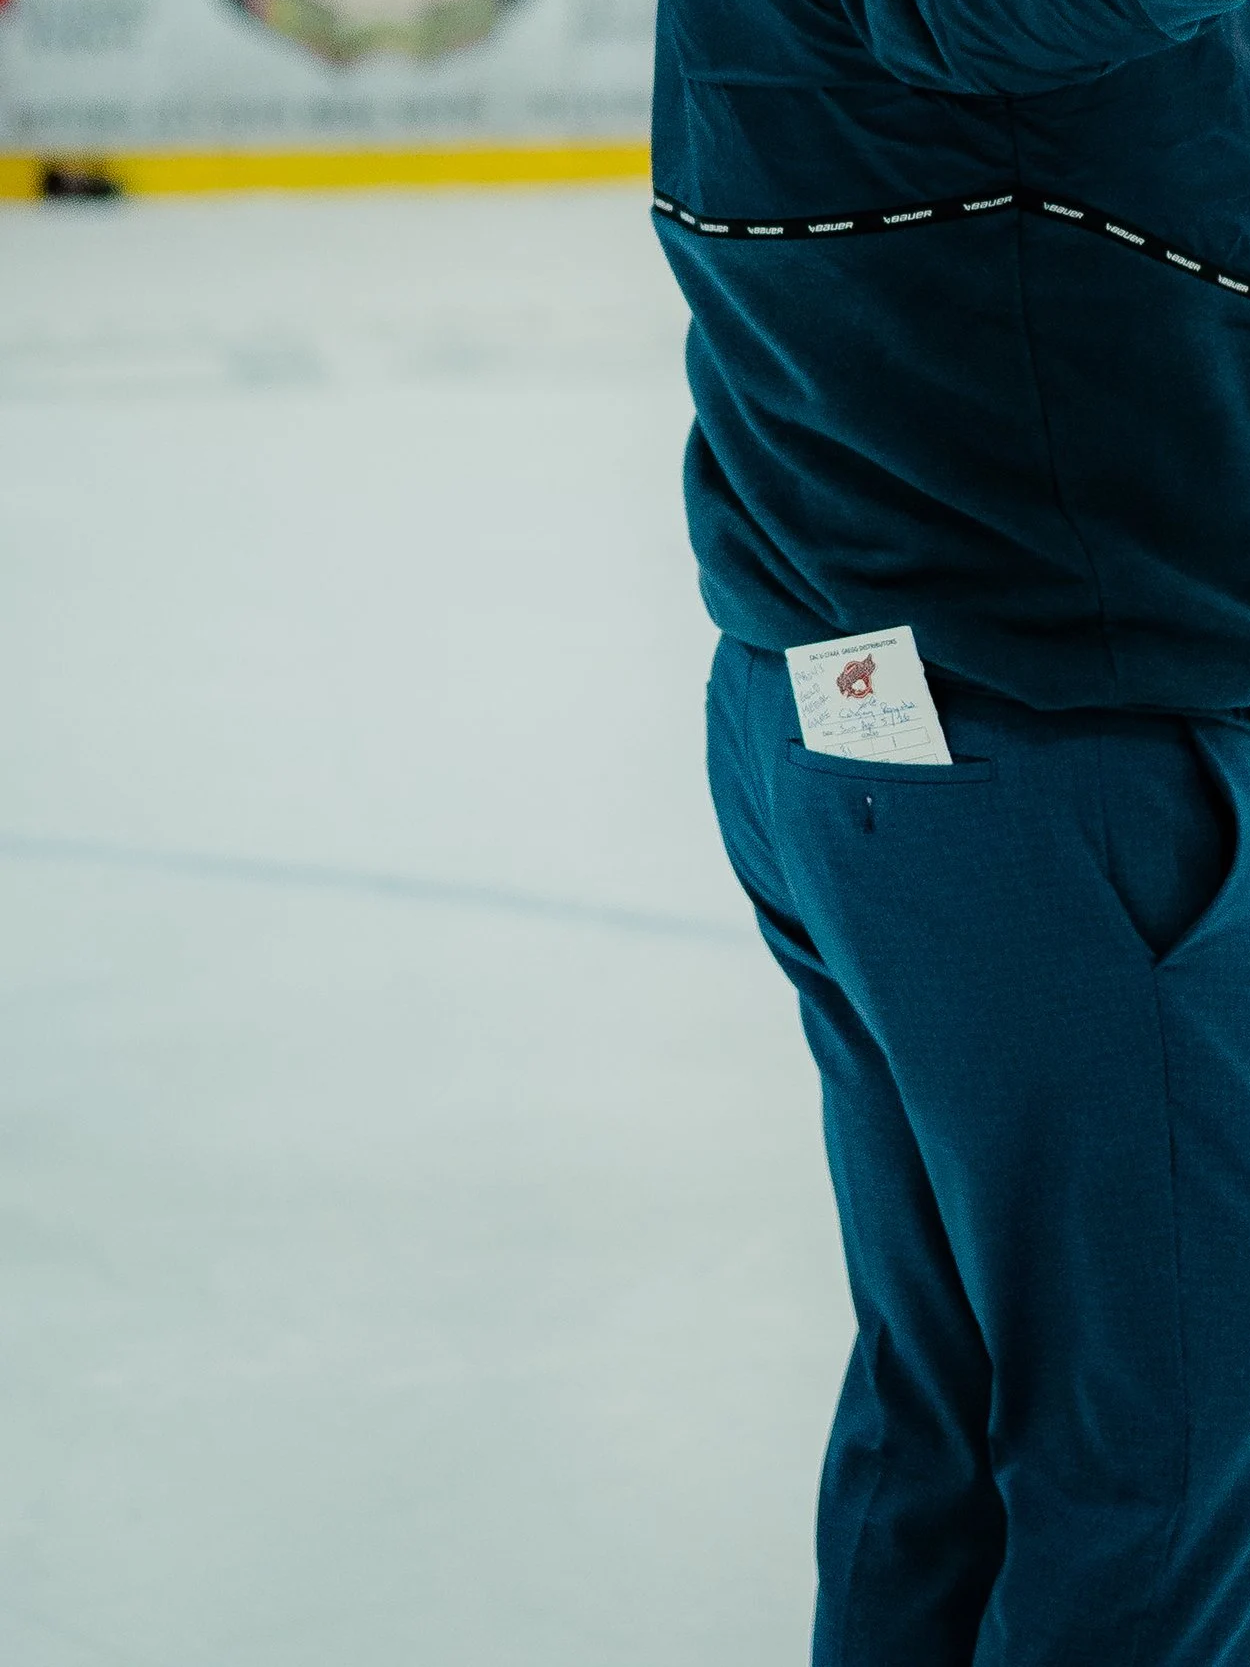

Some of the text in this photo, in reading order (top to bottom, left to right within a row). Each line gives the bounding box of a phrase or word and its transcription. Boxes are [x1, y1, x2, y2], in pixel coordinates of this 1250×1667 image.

[813, 220, 854, 233] BAUER
[888, 209, 932, 224] BAUER
[969, 194, 1013, 211] BAUER
[1049, 203, 1084, 219] BAUER
[1110, 224, 1145, 246] BAUER
[1171, 252, 1201, 272] BAUER
